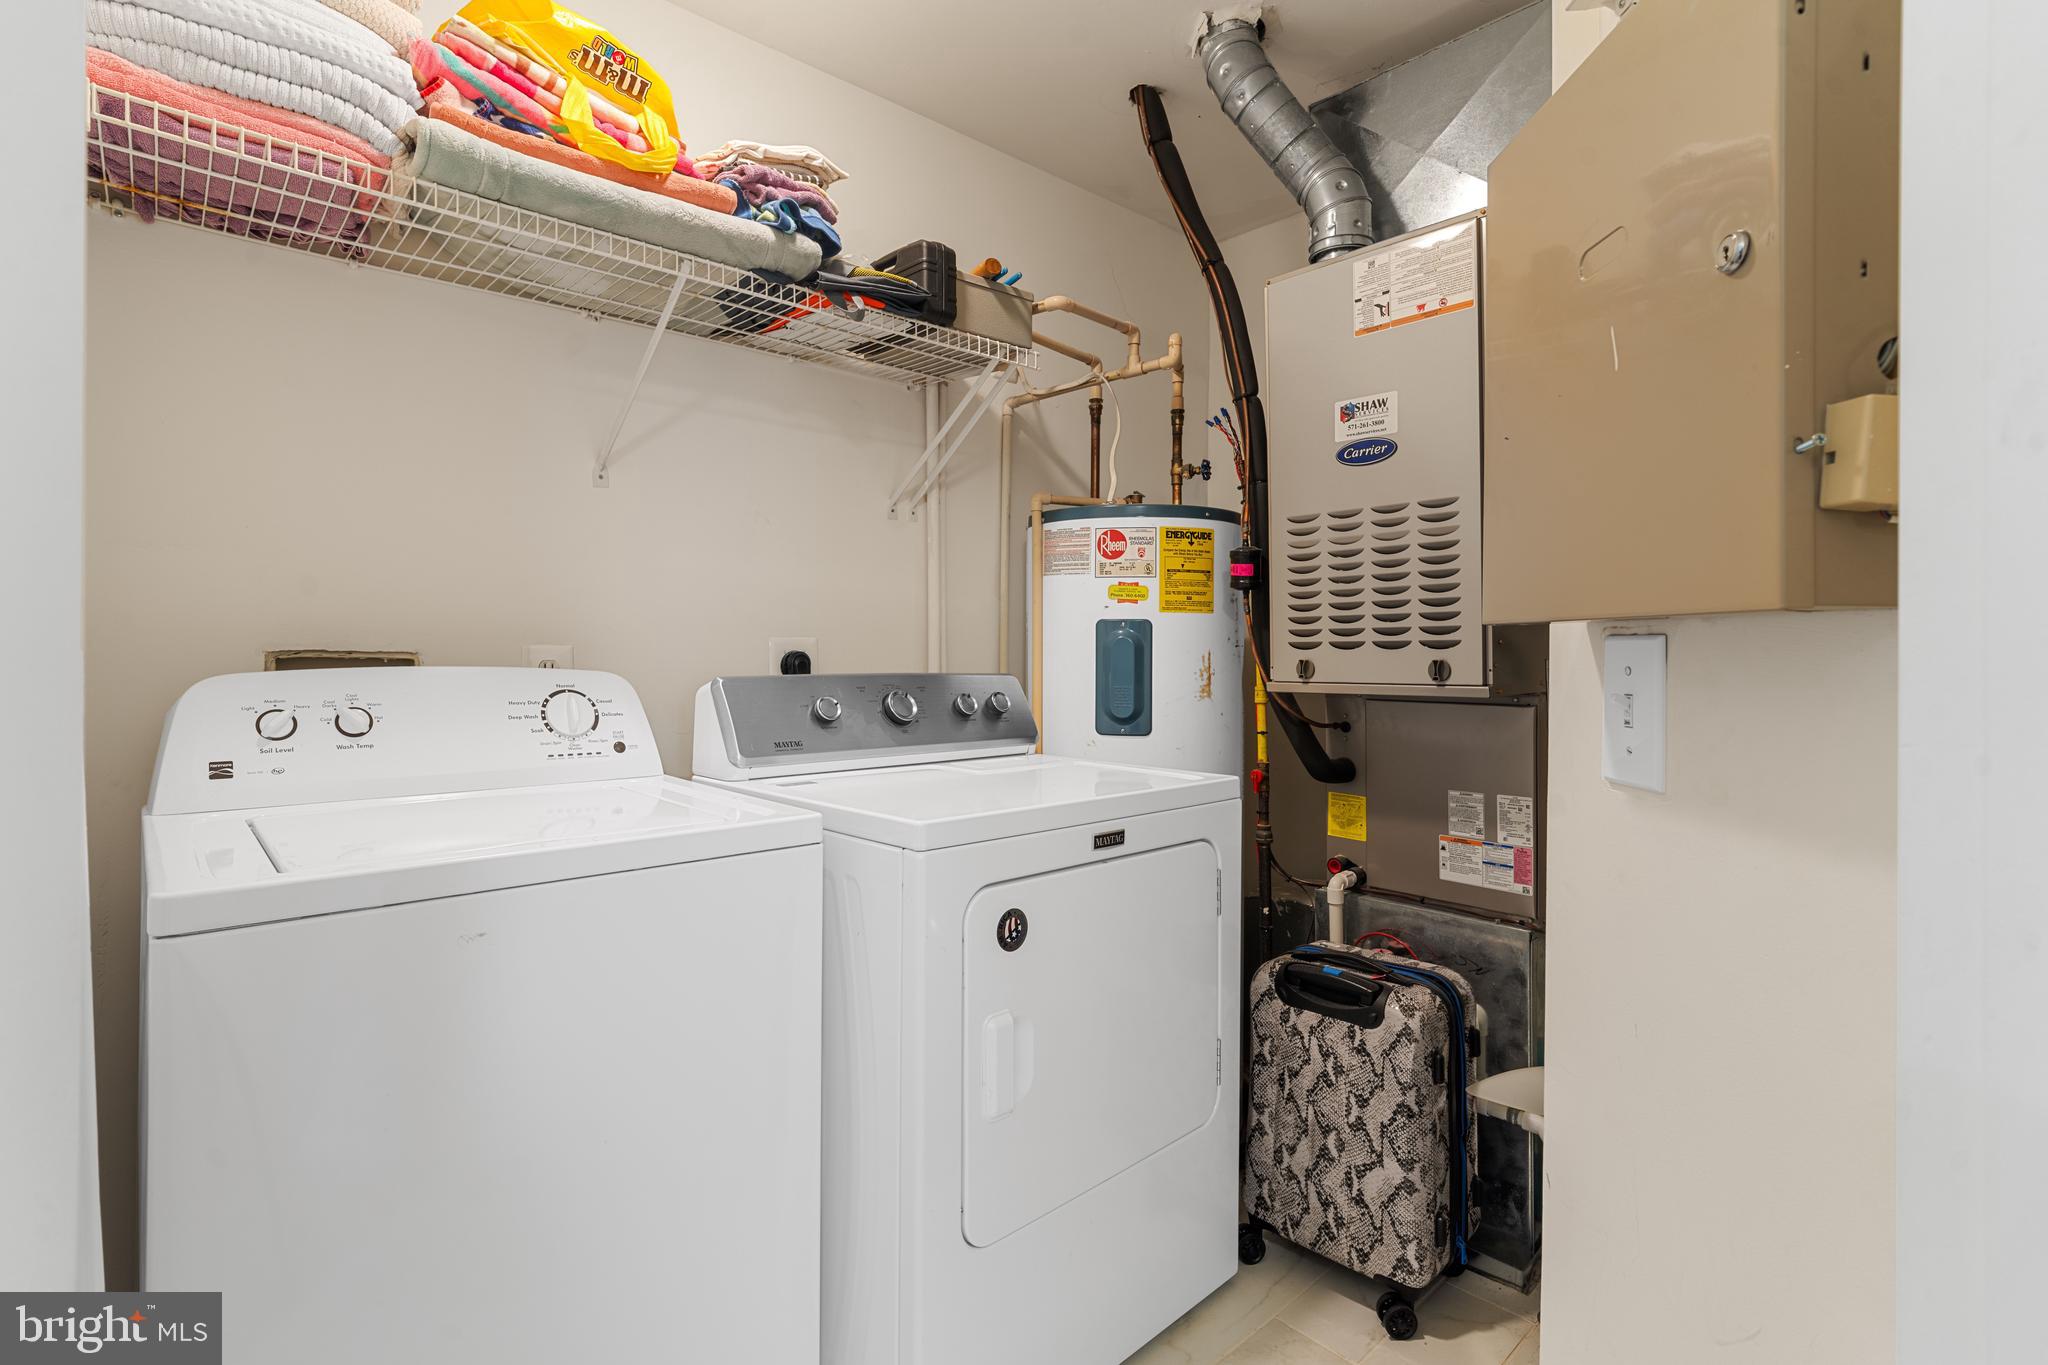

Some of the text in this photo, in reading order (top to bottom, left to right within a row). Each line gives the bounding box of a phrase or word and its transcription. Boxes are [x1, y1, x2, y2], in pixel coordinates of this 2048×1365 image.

[1355, 397, 1388, 412] SHAW
[1347, 419, 1385, 430] 571-261-3800
[1344, 444, 1387, 459] Carrier
[1100, 530, 1126, 556] Rheem
[773, 740, 803, 749] MAYTAG
[1095, 834, 1124, 848] MAYTAG
